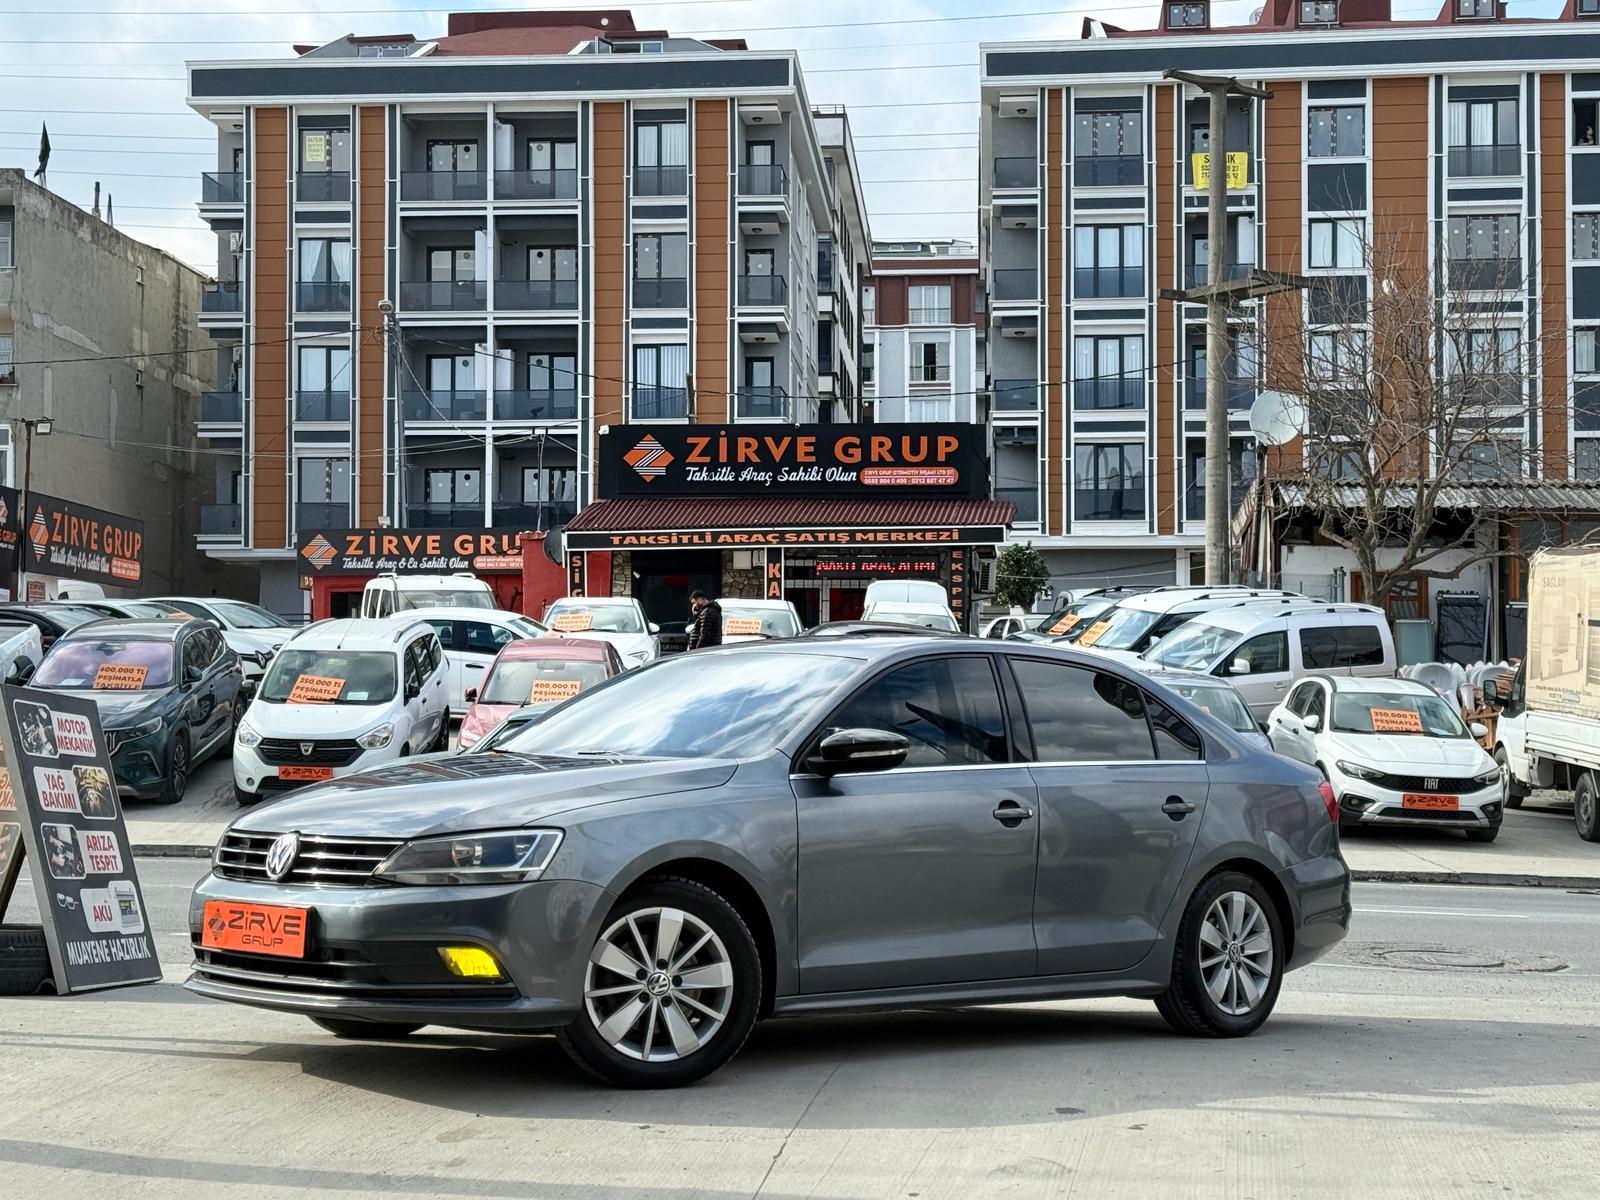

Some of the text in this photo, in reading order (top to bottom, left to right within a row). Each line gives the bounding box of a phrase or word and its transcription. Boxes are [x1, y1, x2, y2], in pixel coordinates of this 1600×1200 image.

[685, 430, 959, 463] ZİRVE GRUP
[685, 466, 857, 487] Taksitle Araç Sahibi Olun
[103, 525, 142, 559] GRUP
[345, 530, 441, 555] ZİRVE
[610, 528, 960, 545] TAKSİTLİ ARAÇ SATIŞ MERKEZİ
[343, 557, 374, 569] Taksitle
[375, 557, 397, 572] Araç
[419, 556, 448, 569] Sahibi
[448, 556, 469, 569] Olun
[57, 717, 88, 736] MOTOR
[44, 770, 66, 792] YAĞ
[1423, 778, 1440, 790] FIAT
[41, 791, 77, 810] BAKIMI
[86, 835, 115, 852] ARIZA
[241, 934, 284, 947] GRUP
[66, 936, 152, 966] MUAYENE HAZIRLIK
